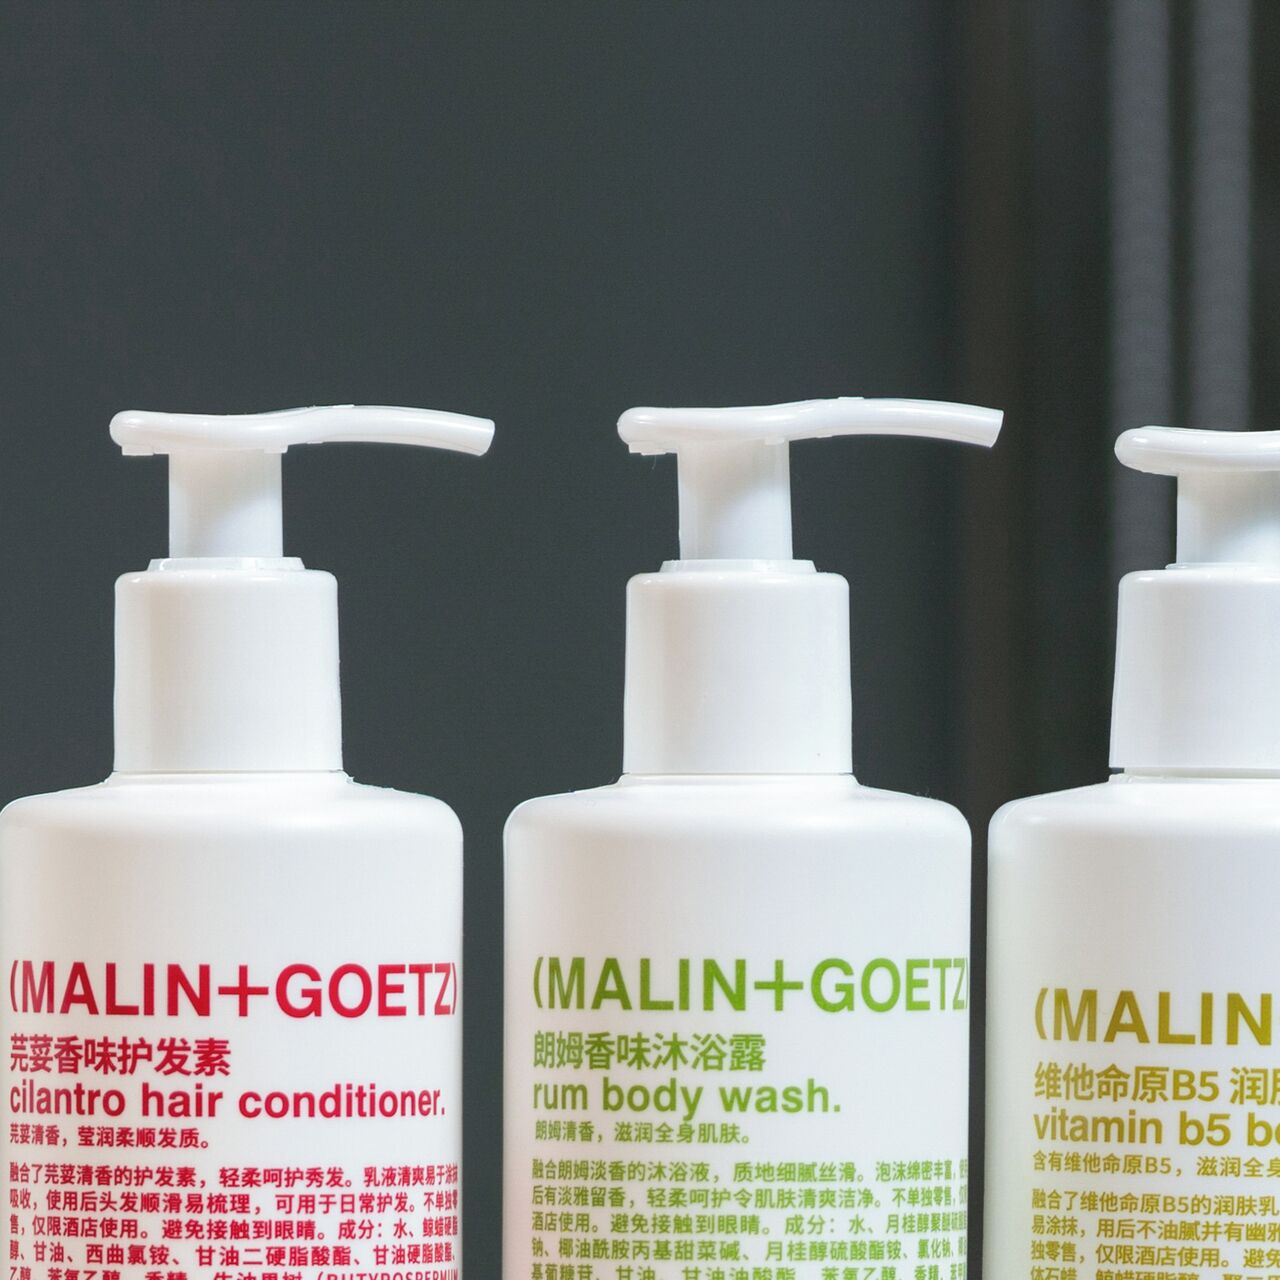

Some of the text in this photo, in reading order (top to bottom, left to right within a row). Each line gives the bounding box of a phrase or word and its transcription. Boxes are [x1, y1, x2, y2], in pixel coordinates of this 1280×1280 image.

[9, 959, 458, 1020] (MALIN+GOETZ)
[9, 1078, 446, 1120] cilantro hair conditioner.
[532, 1075, 841, 1123] rum body wash.
[1033, 1060, 1221, 1105] 维他命原B5
[1032, 1105, 1164, 1146] vitamin
[1177, 1109, 1232, 1148] b5
